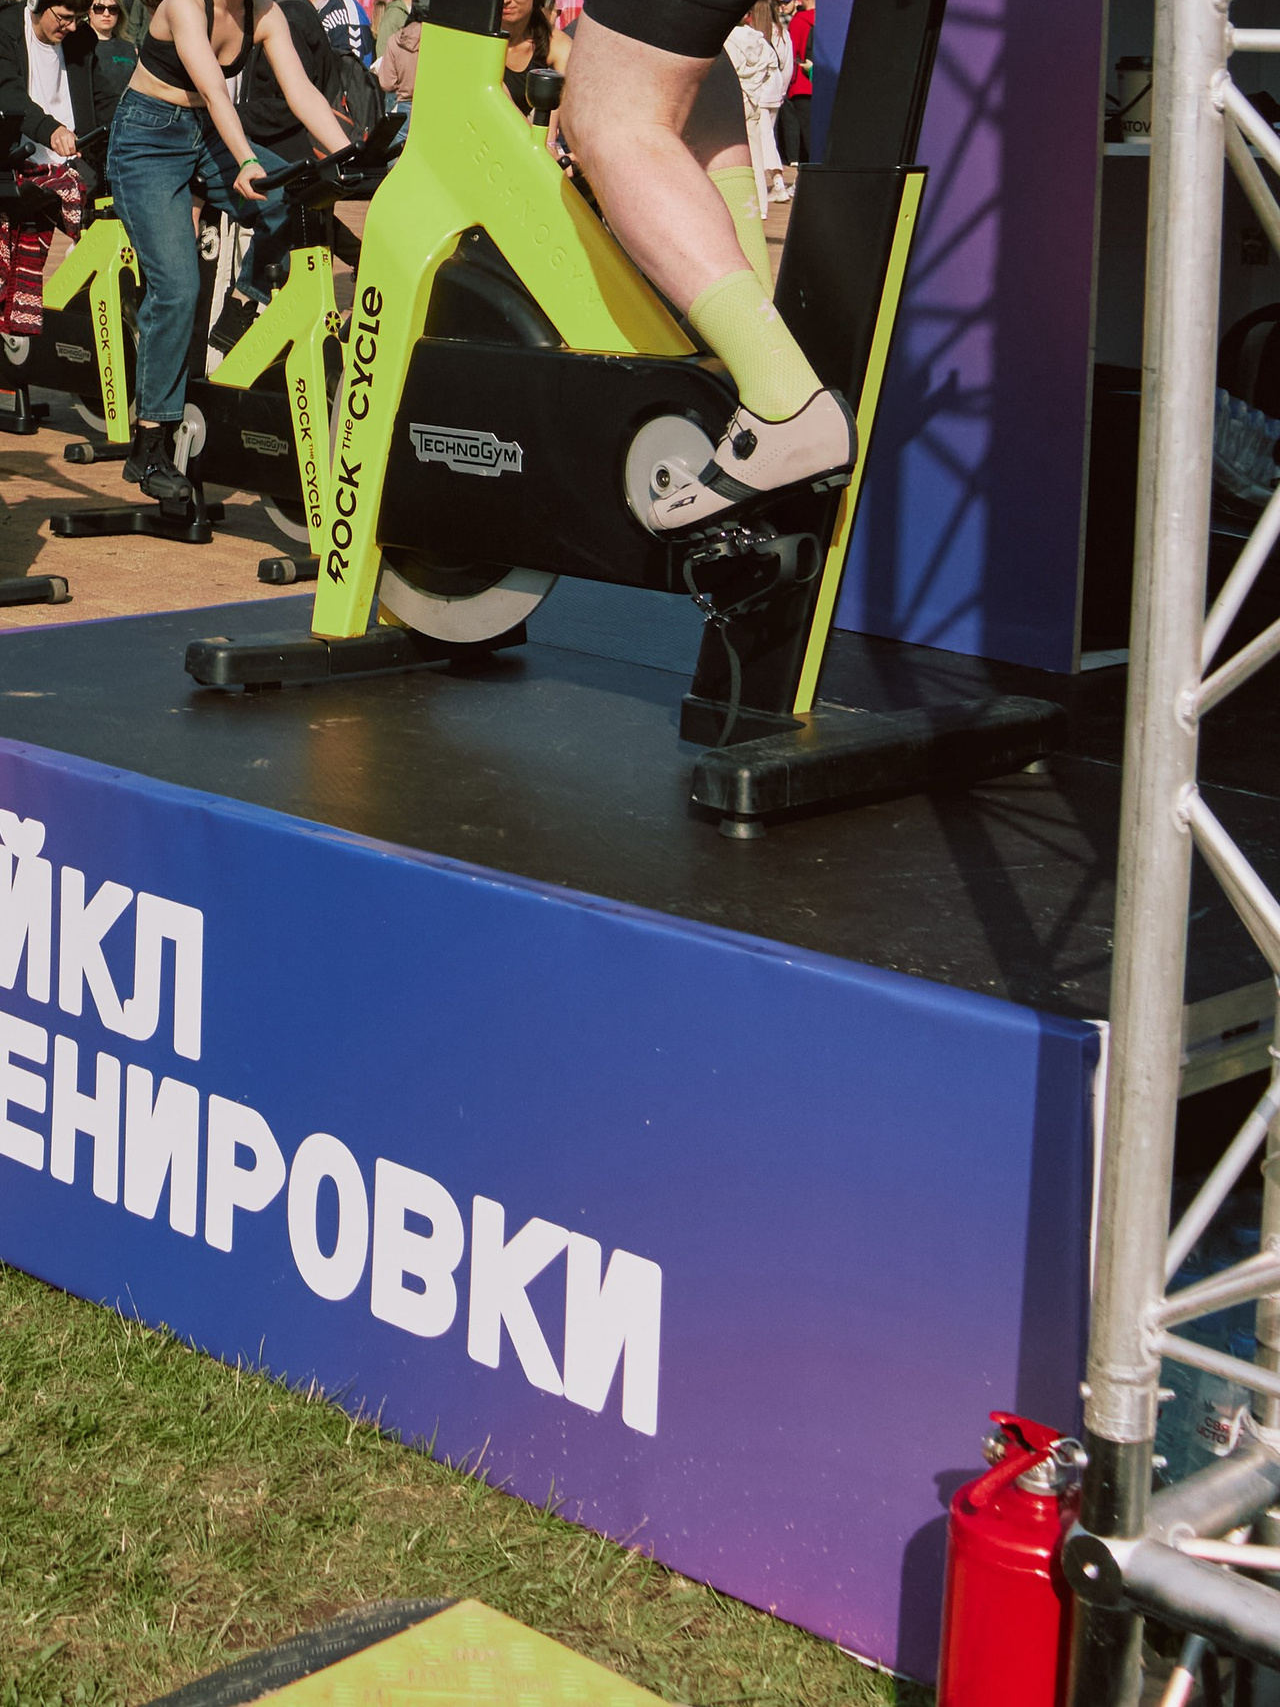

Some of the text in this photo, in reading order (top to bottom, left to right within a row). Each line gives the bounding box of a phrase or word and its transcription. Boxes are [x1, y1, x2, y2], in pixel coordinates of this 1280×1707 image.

[307, 255, 315, 271] 5
[98, 299, 110, 351] ROCK
[295, 377, 312, 442] ROCK
[413, 429, 517, 468] TECHNOGYM
[327, 455, 362, 585] ROCK
